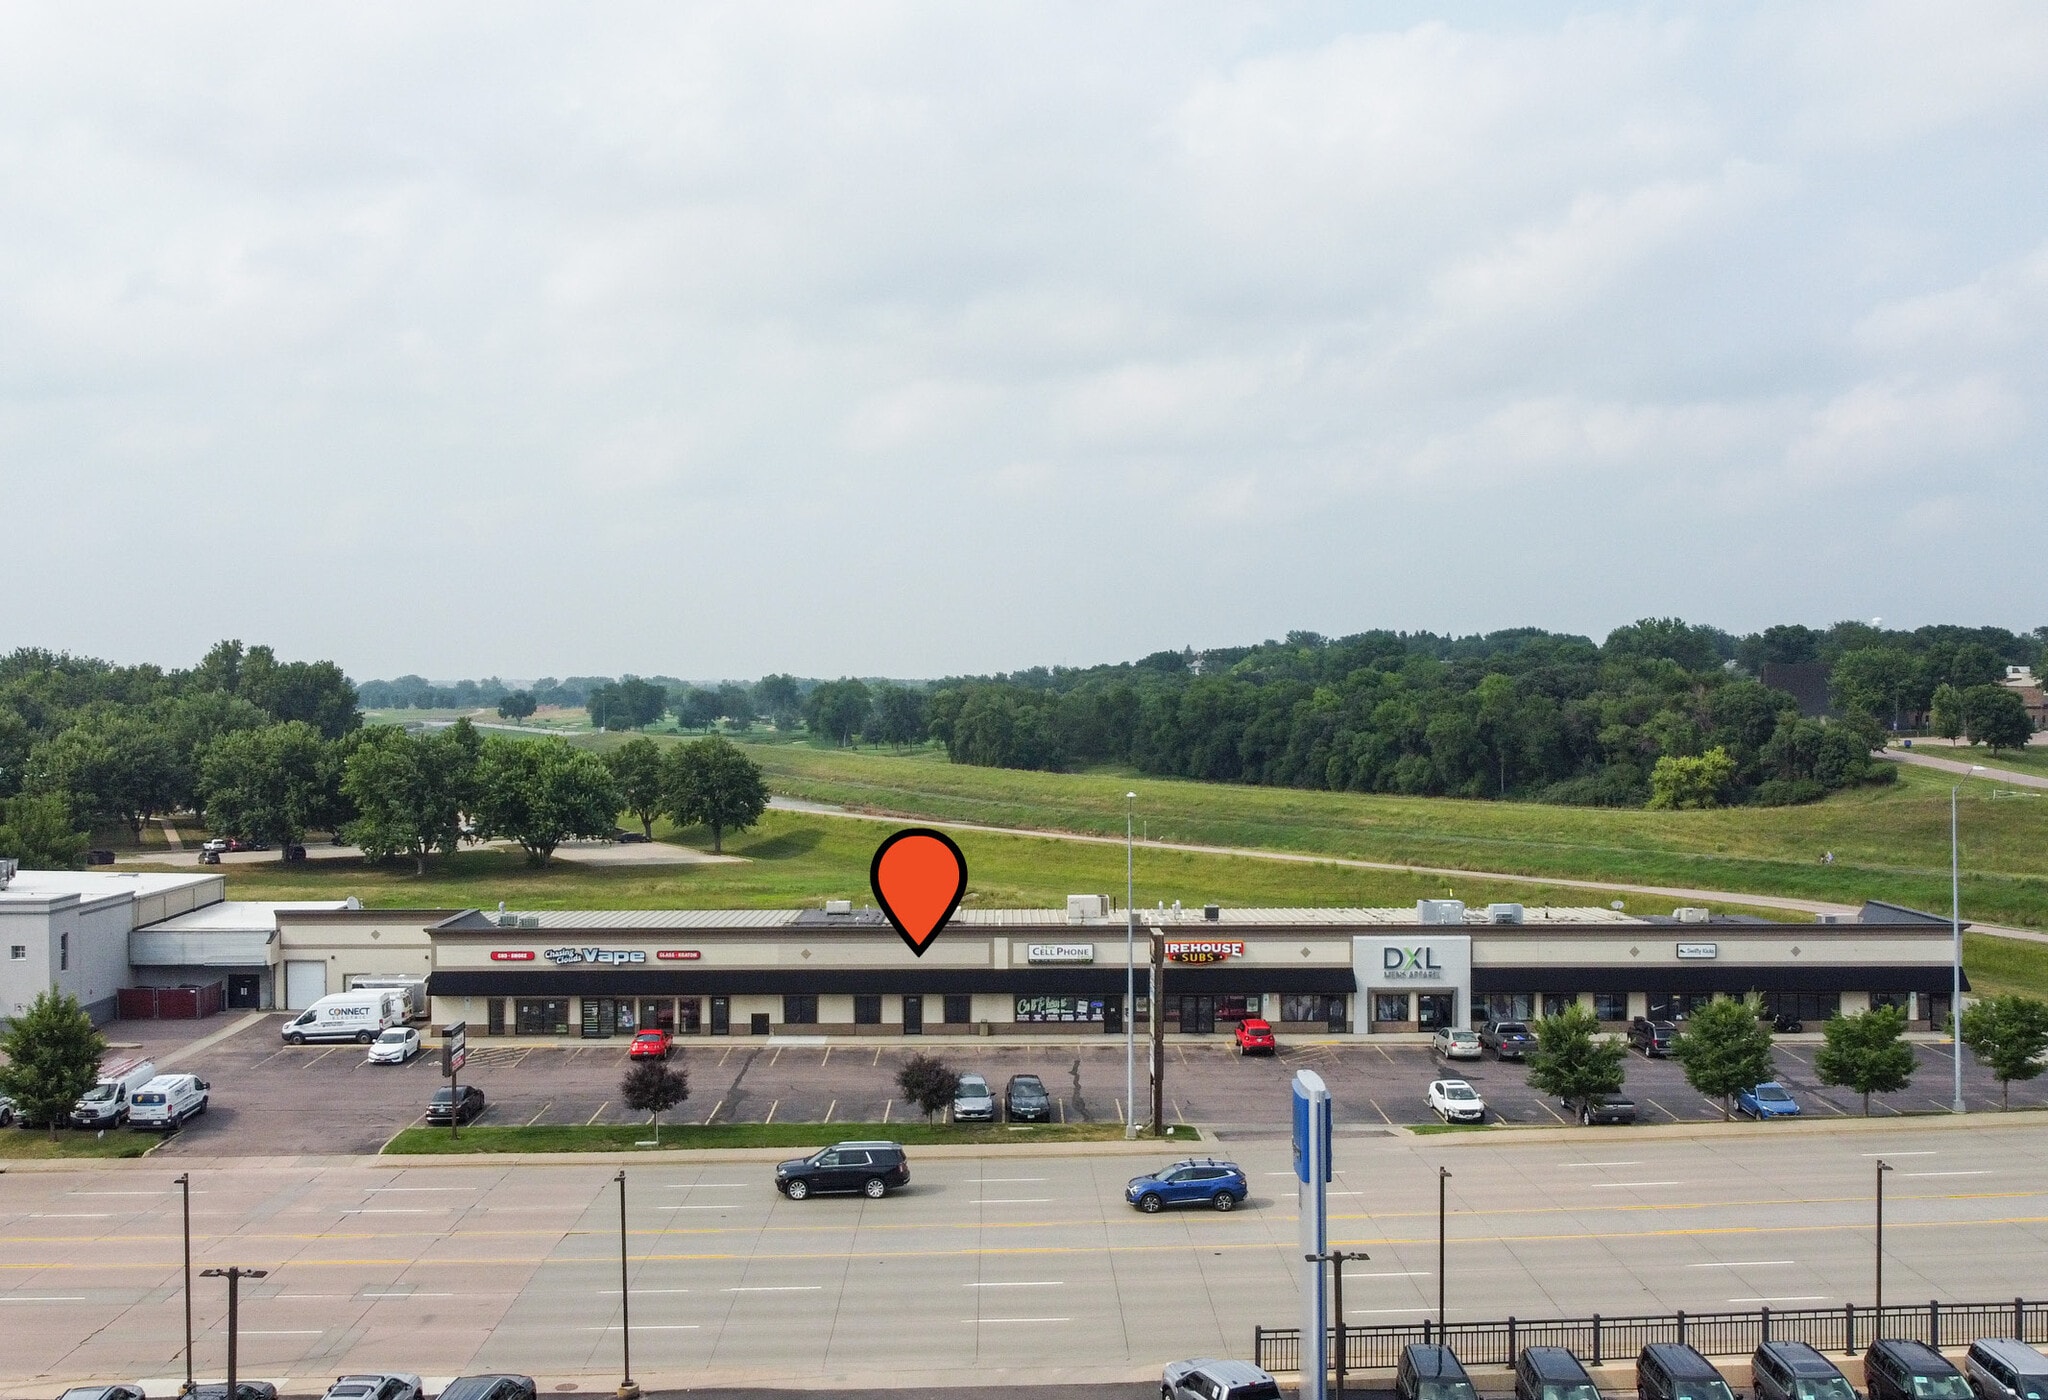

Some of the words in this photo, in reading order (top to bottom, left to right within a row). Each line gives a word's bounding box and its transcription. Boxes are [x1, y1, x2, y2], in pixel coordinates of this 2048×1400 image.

[1056, 947, 1089, 956] PHONE
[1164, 943, 1242, 957] IREHOUSE
[556, 954, 582, 964] Clouds
[582, 948, 645, 966] Vape
[1181, 953, 1214, 962] SUBS
[1384, 946, 1441, 970] DXL
[328, 1007, 370, 1016] CONNECT
